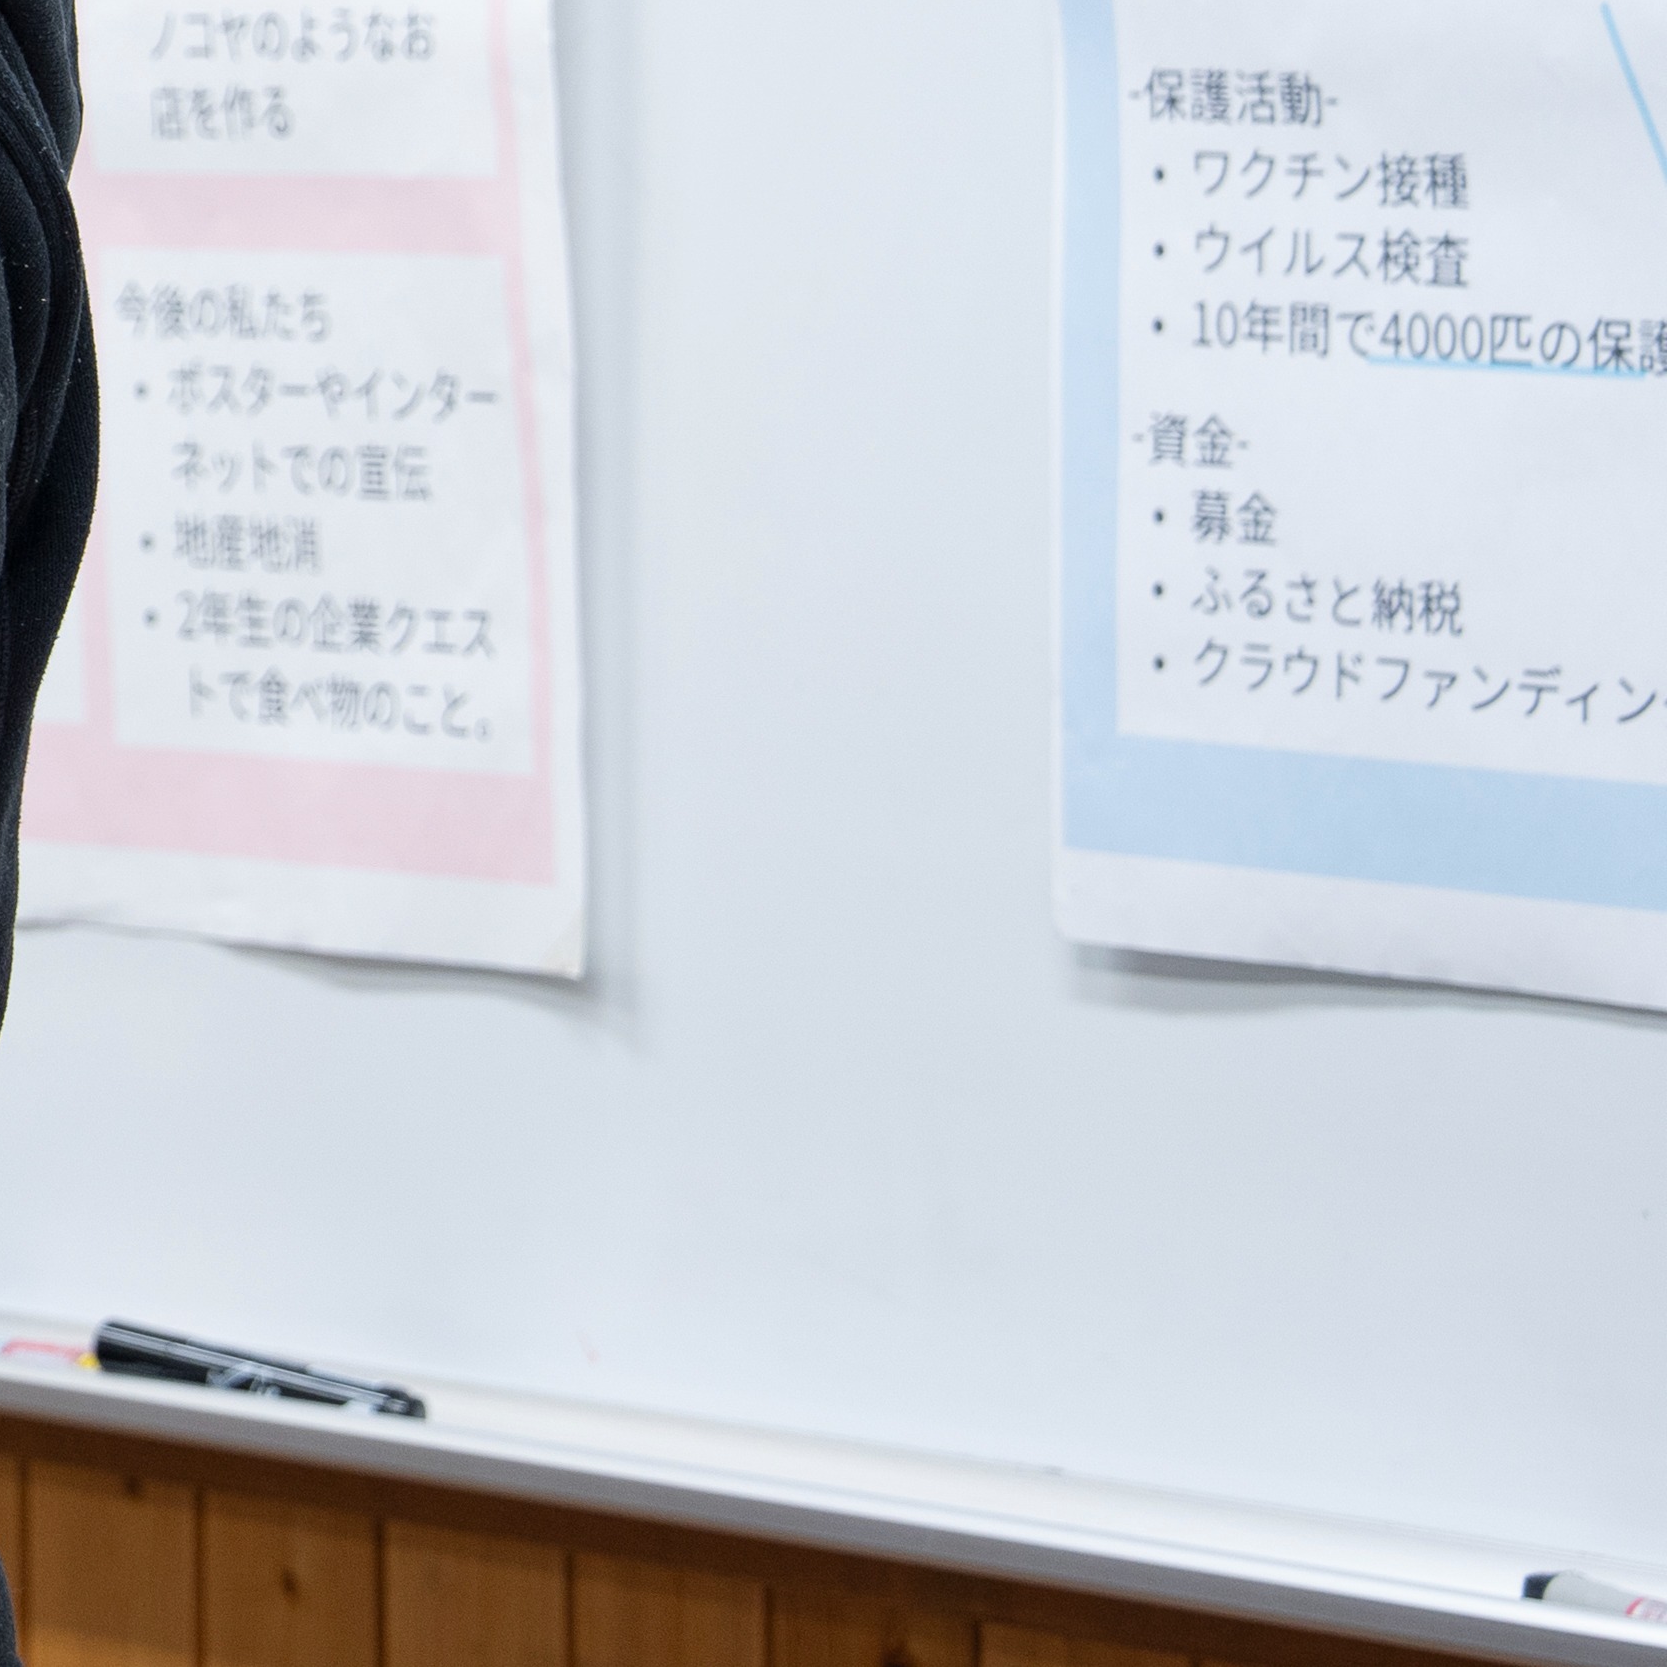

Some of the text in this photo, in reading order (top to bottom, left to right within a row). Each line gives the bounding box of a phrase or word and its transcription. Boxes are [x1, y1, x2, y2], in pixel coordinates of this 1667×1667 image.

[150, 84, 296, 140] 店を作る
[1192, 147, 1470, 210] ワクチン接種
[1193, 221, 1470, 289] ウイルス検査
[115, 280, 332, 342] 今後の私たち
[172, 440, 433, 501] ネットでの宣伝
[1191, 487, 1278, 546] 募金
[1191, 566, 1464, 636] ふるさと納税
[1193, 636, 1667, 724] クラウドファンディン
